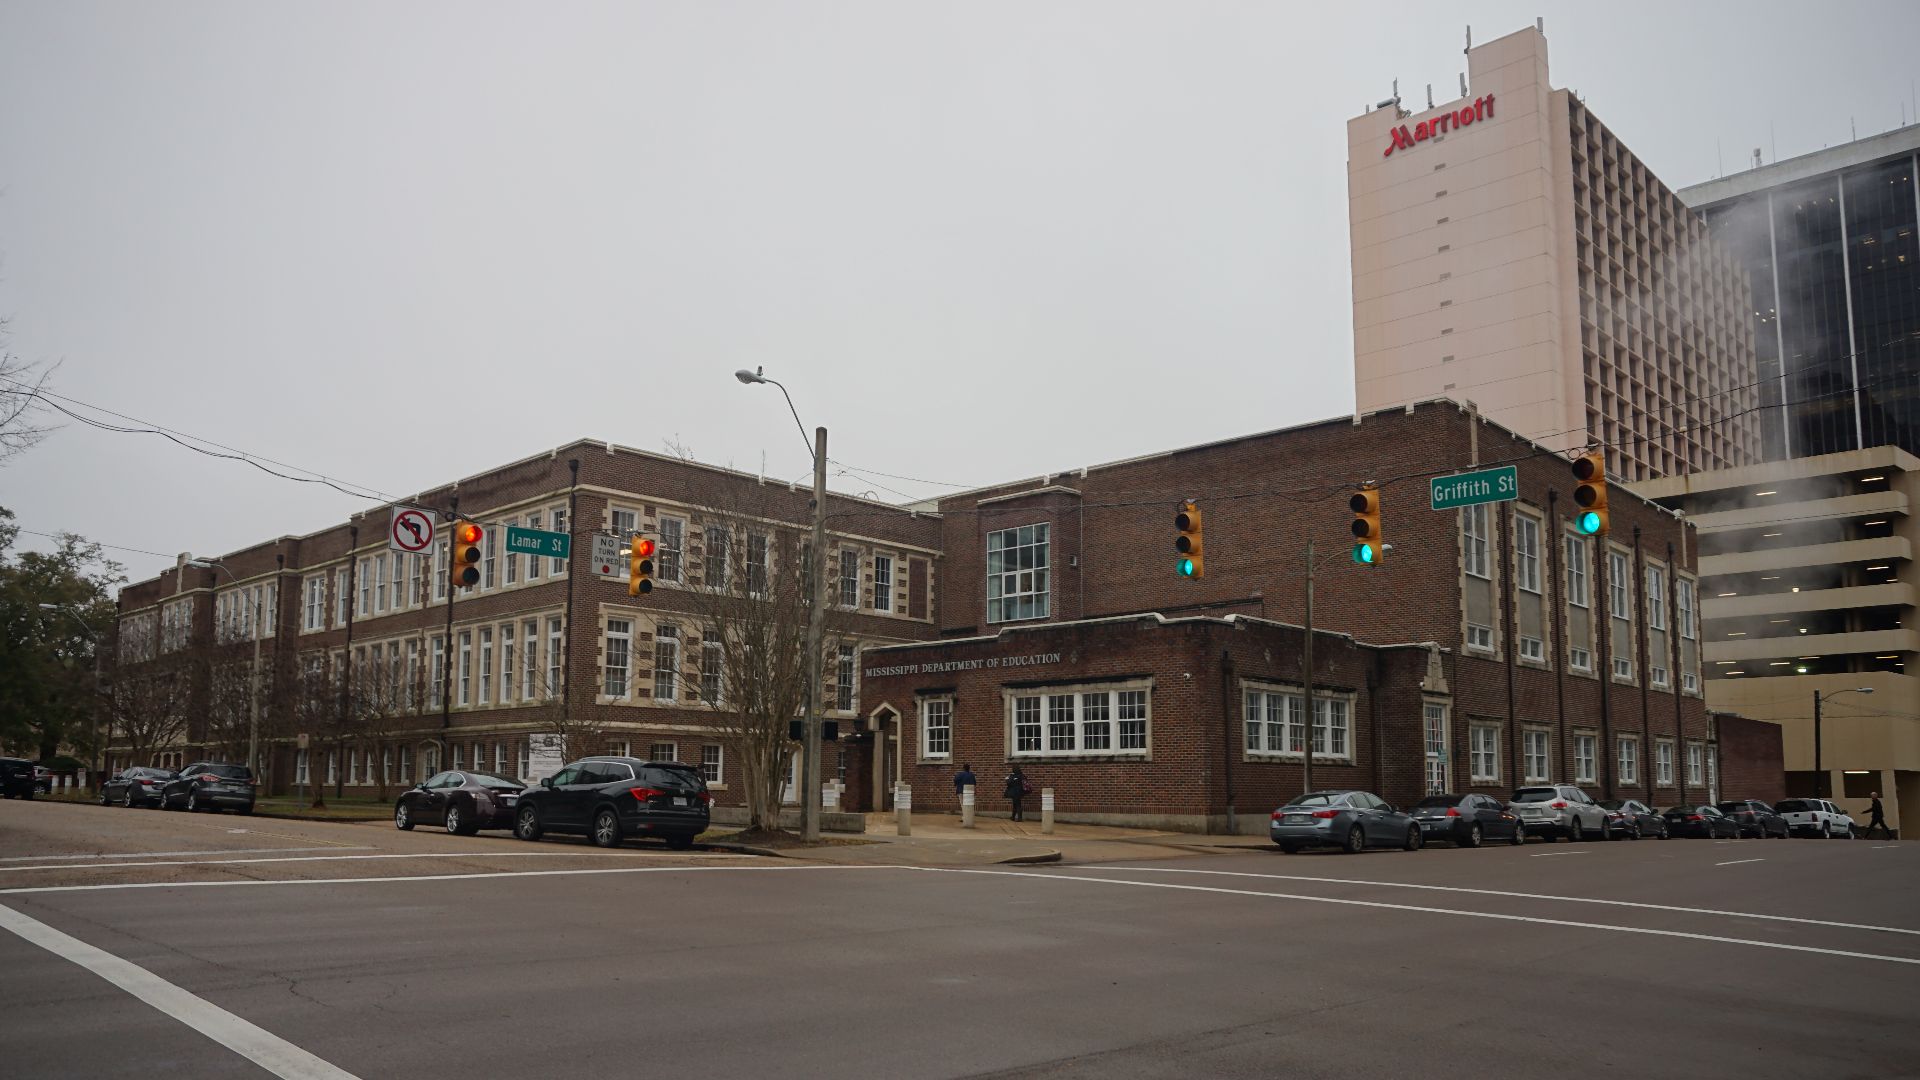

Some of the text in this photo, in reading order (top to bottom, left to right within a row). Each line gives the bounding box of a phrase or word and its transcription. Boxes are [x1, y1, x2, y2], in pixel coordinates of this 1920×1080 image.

[1384, 93, 1495, 157] Marriott
[1434, 475, 1514, 502] Griffith St
[511, 532, 562, 552] Lamar St
[598, 548, 616, 556] TURN
[600, 538, 615, 548] NO
[594, 555, 619, 566] ON RED
[865, 652, 1060, 677] MISSISSIPPI DEPARTMENT OF EDUCATION
